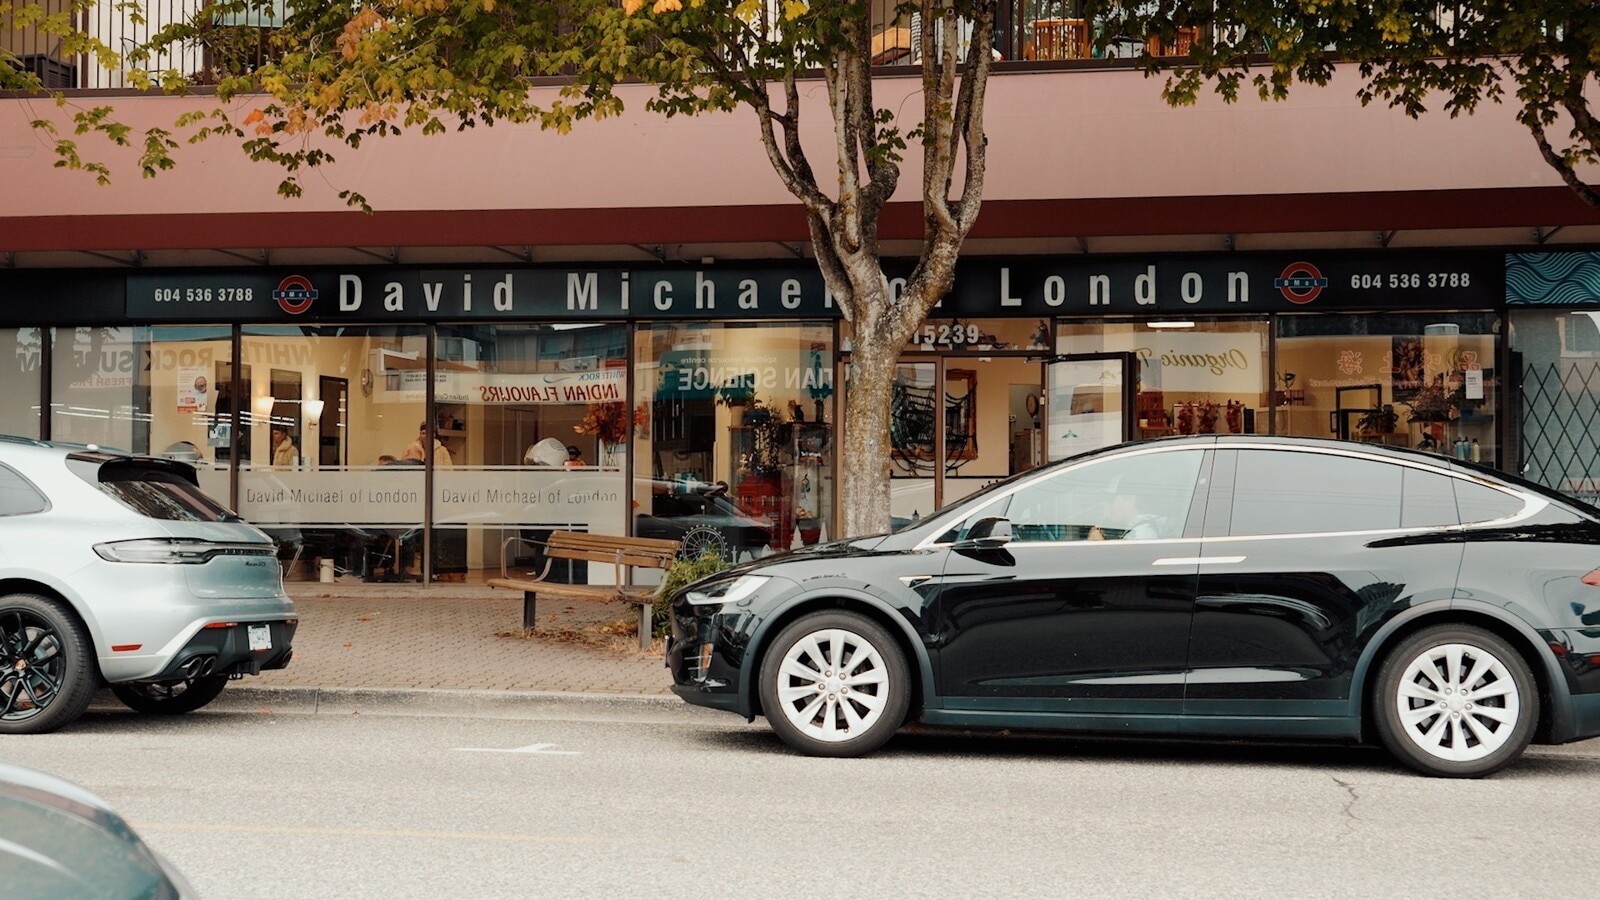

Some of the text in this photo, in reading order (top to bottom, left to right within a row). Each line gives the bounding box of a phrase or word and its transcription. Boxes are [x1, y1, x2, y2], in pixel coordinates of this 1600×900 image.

[339, 273, 513, 312] David
[566, 271, 834, 311] Michael
[1001, 264, 1250, 307] London
[1350, 272, 1470, 289] 604 536 3788
[154, 288, 253, 302] 604 536 3788
[913, 323, 980, 345] 15239
[247, 488, 284, 503] David
[368, 489, 417, 503] London
[442, 488, 480, 503] David
[487, 488, 541, 503] Michael
[548, 489, 560, 504] of
